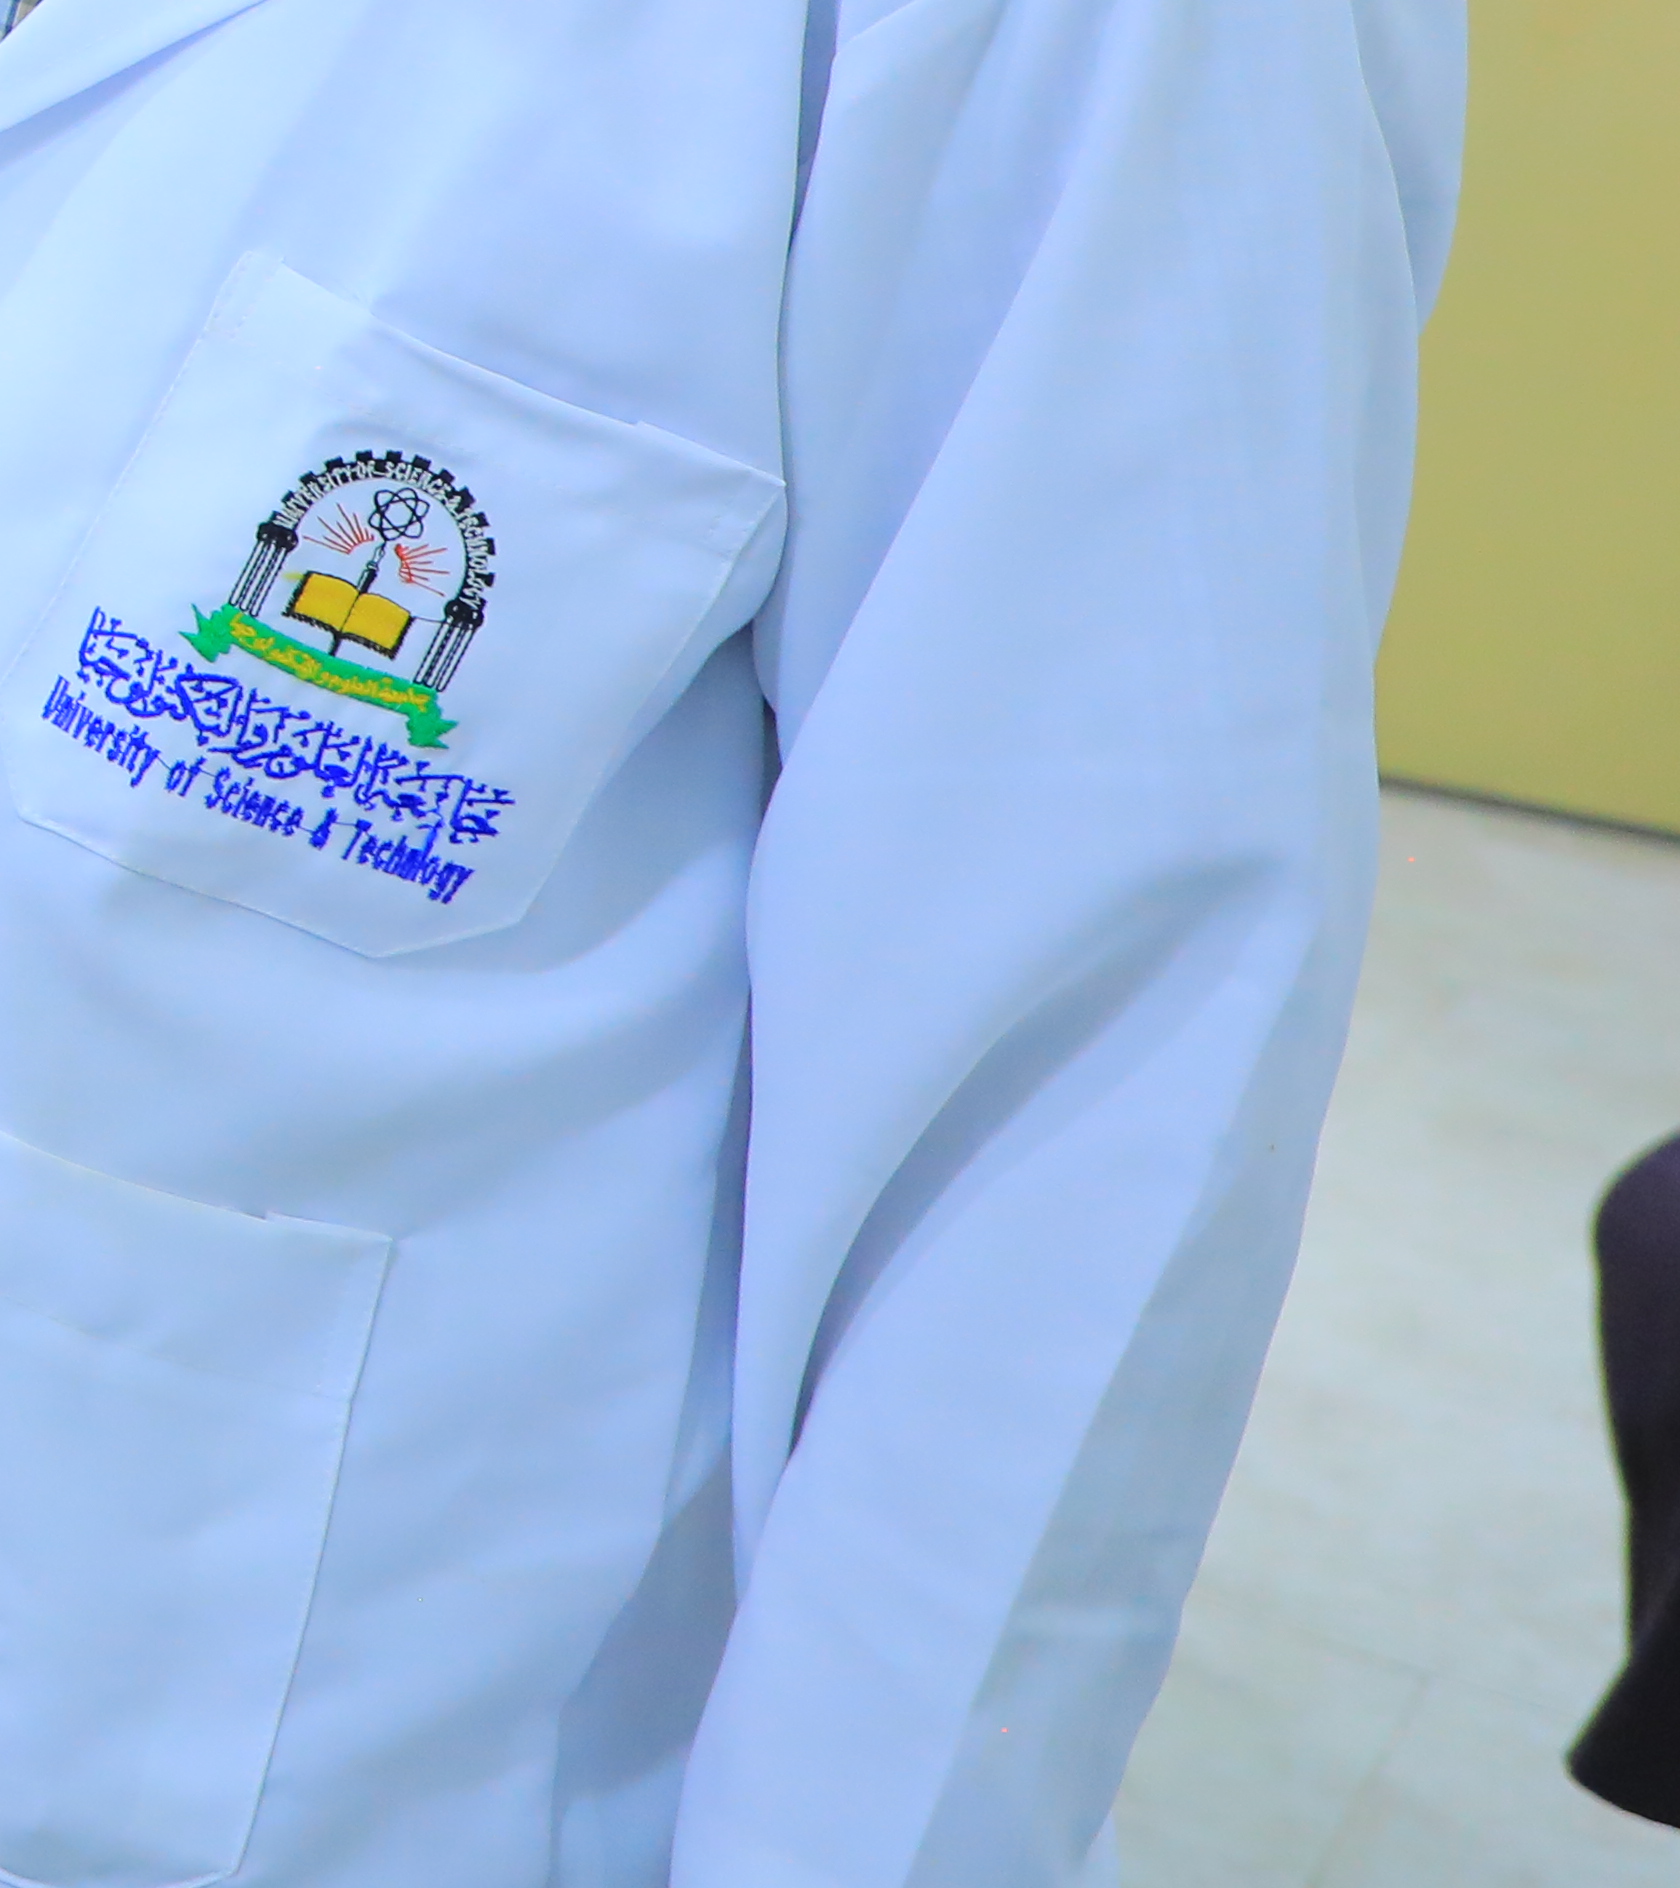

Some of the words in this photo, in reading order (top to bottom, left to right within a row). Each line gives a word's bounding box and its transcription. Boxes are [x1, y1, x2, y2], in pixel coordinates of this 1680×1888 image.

[384, 461, 451, 500] SCIENCE
[42, 674, 162, 787] University
[166, 756, 207, 797] of
[205, 767, 305, 836] Science
[341, 819, 475, 905] Technology
